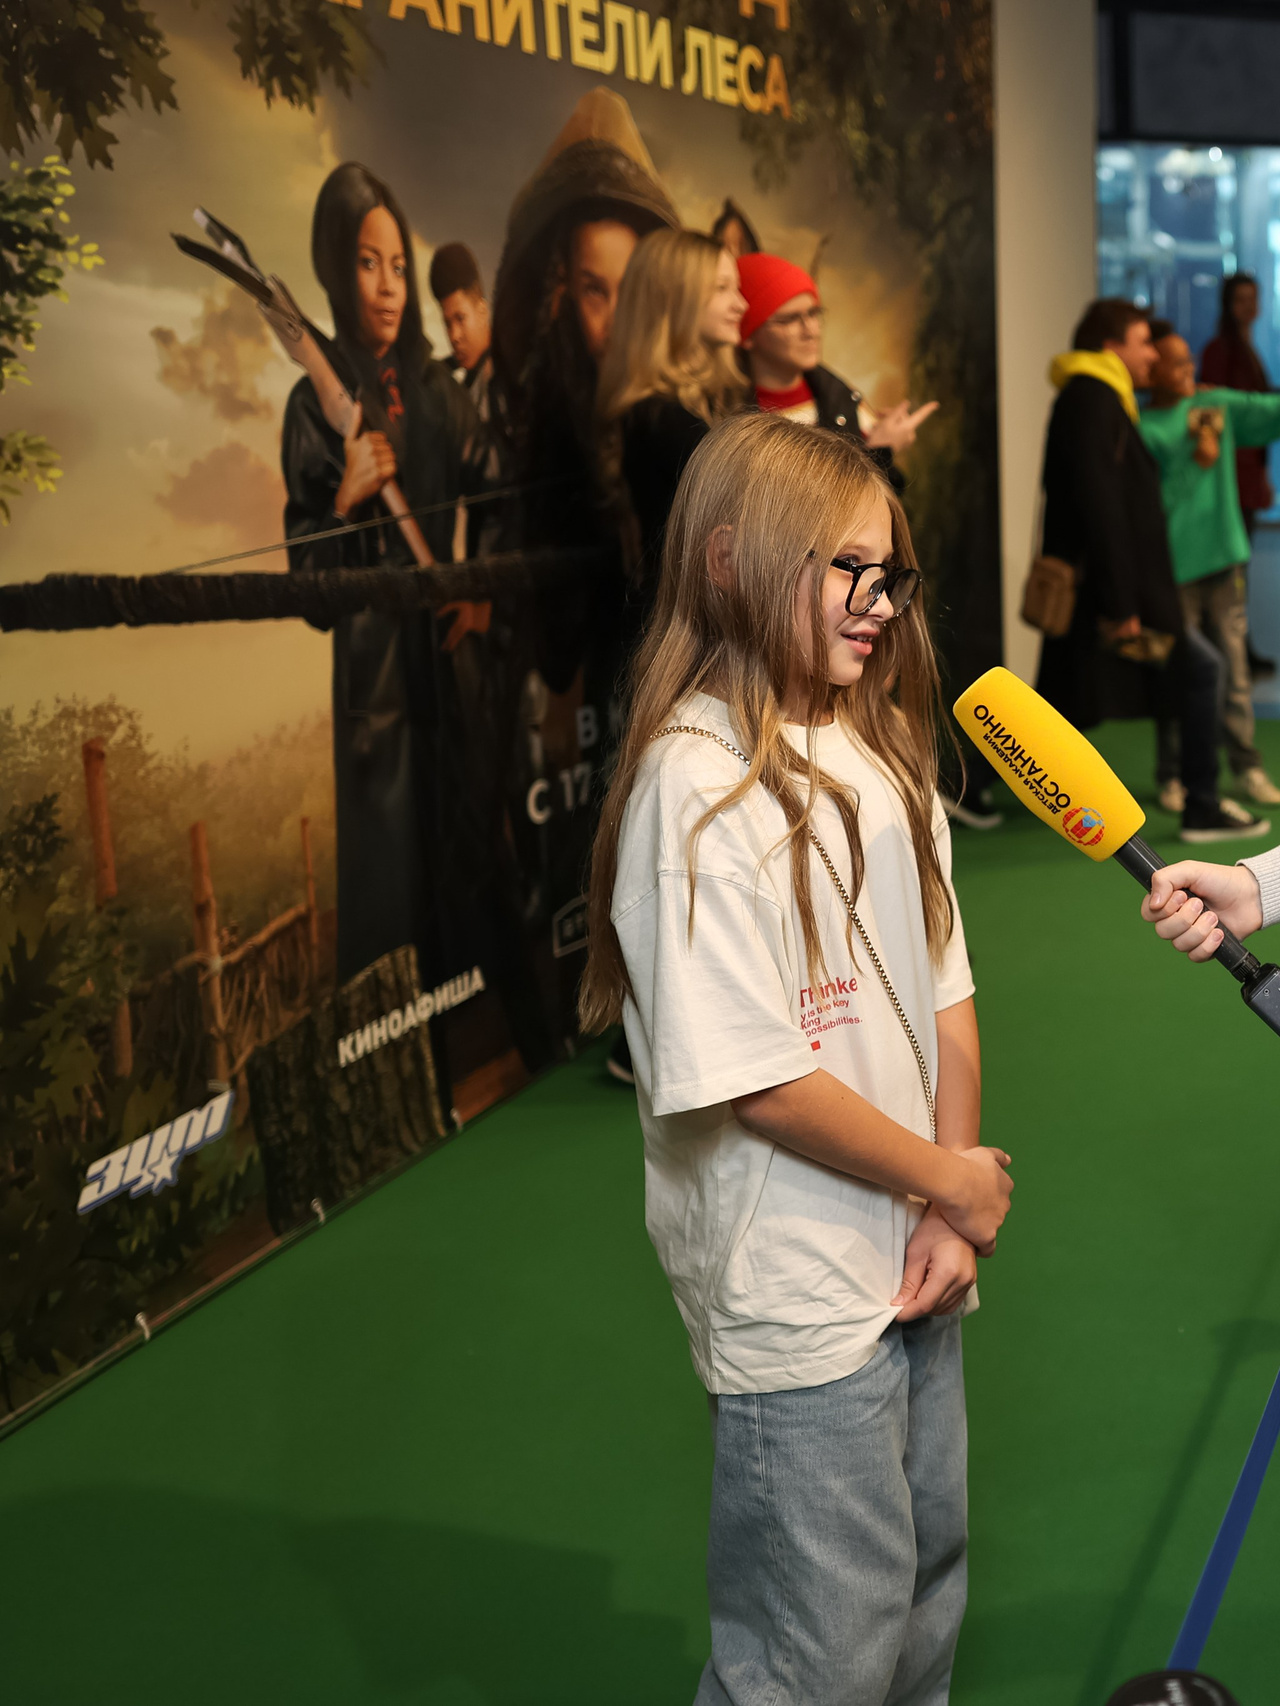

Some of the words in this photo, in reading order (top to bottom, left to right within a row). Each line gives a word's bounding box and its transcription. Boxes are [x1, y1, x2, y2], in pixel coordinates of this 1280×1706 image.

[681, 25, 792, 120] ЛЕСА
[973, 704, 1071, 809] ОСТАНКИНО
[982, 732, 1026, 778] АКАДЕМИЯ
[558, 761, 592, 812] 17
[1023, 778, 1062, 815] ДЕТСКАЯ
[337, 964, 486, 1069] КИНОАФИША
[807, 1009, 815, 1018] is
[816, 1003, 832, 1014] te
[832, 999, 849, 1008] key
